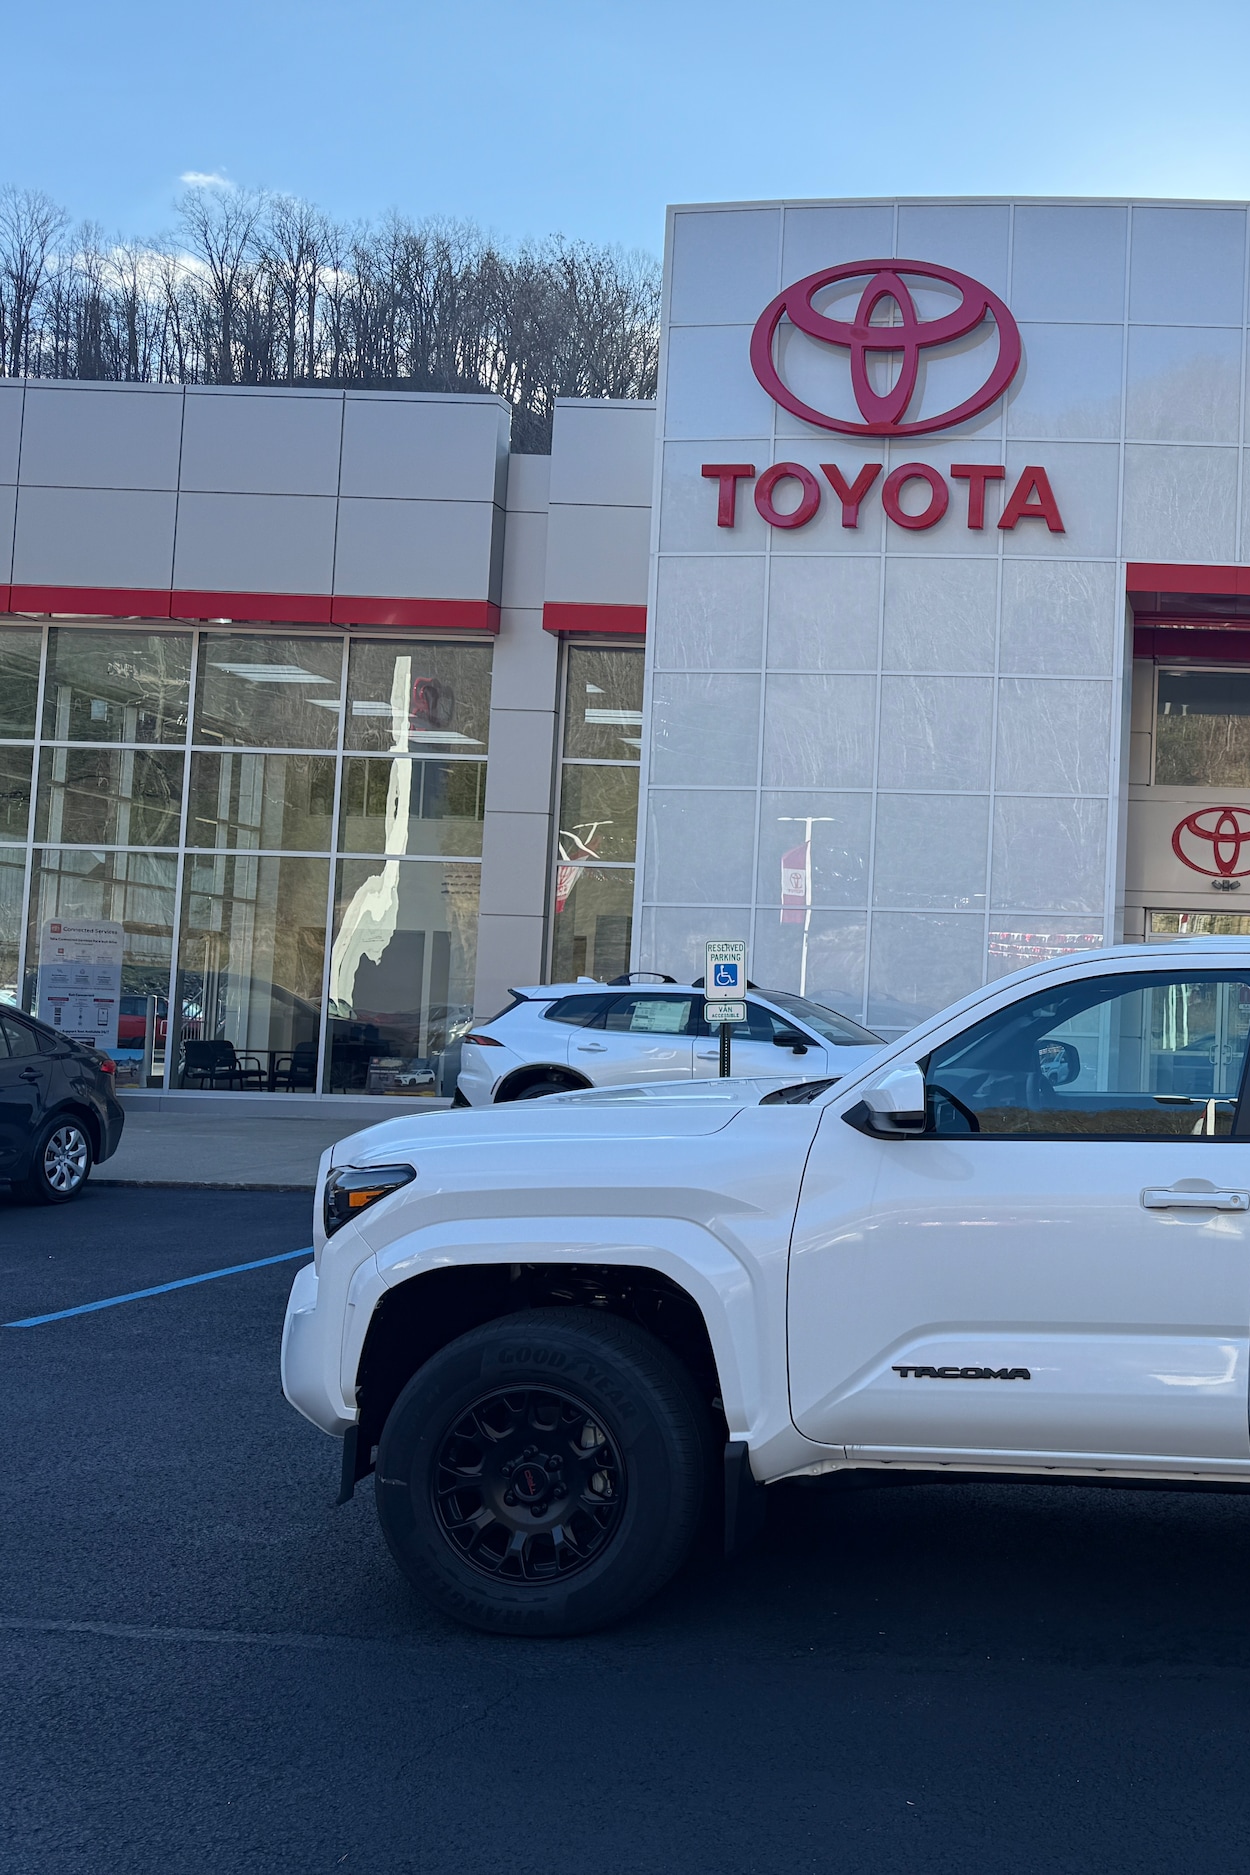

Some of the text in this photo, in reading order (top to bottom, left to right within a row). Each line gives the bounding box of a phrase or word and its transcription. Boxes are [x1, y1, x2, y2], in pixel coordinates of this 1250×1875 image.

[702, 462, 1065, 533] TOYOTA
[707, 944, 744, 952] RESERVED
[710, 953, 741, 961] PARKING
[891, 1366, 1031, 1380] TACOMA
